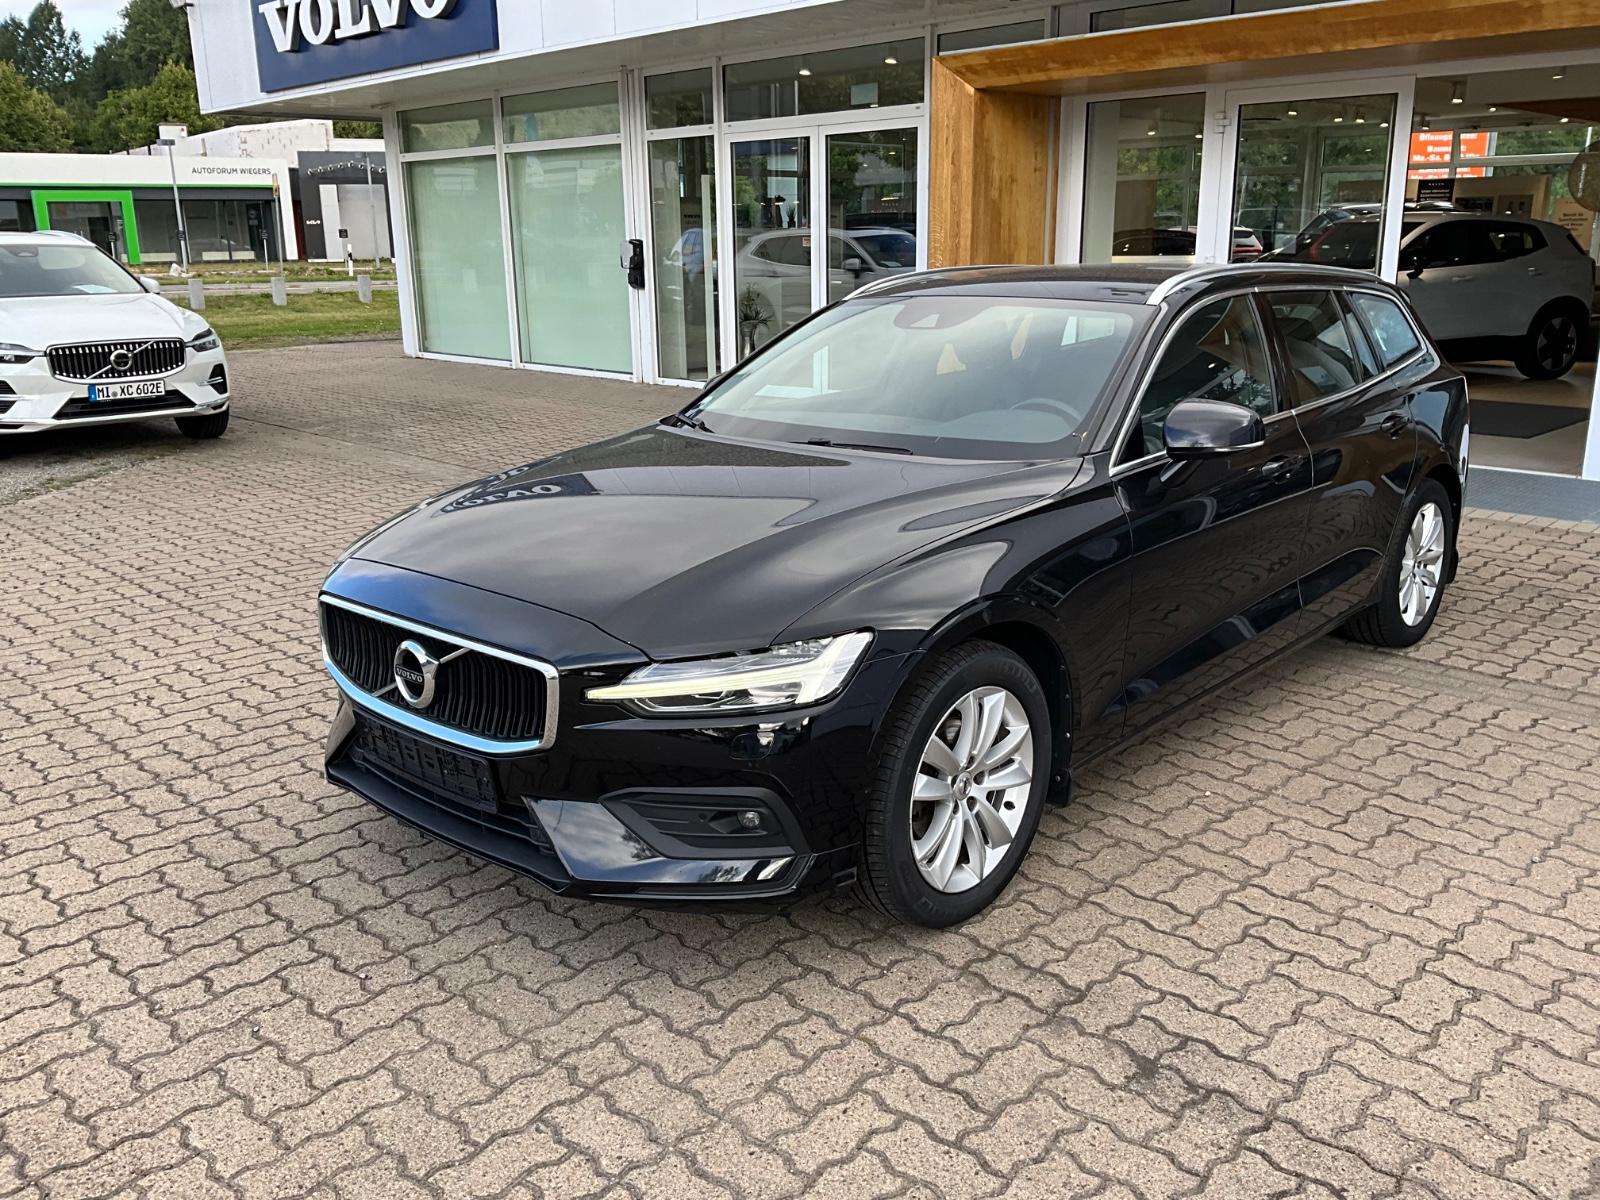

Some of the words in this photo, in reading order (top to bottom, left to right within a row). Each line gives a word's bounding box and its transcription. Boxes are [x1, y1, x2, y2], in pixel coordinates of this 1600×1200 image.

[192, 167, 238, 175] AUTOFORUM
[239, 167, 271, 175] WIEGERS
[97, 386, 111, 399] MI
[120, 384, 134, 397] XC
[136, 382, 163, 396] 602E
[396, 667, 423, 683] VOLVO
